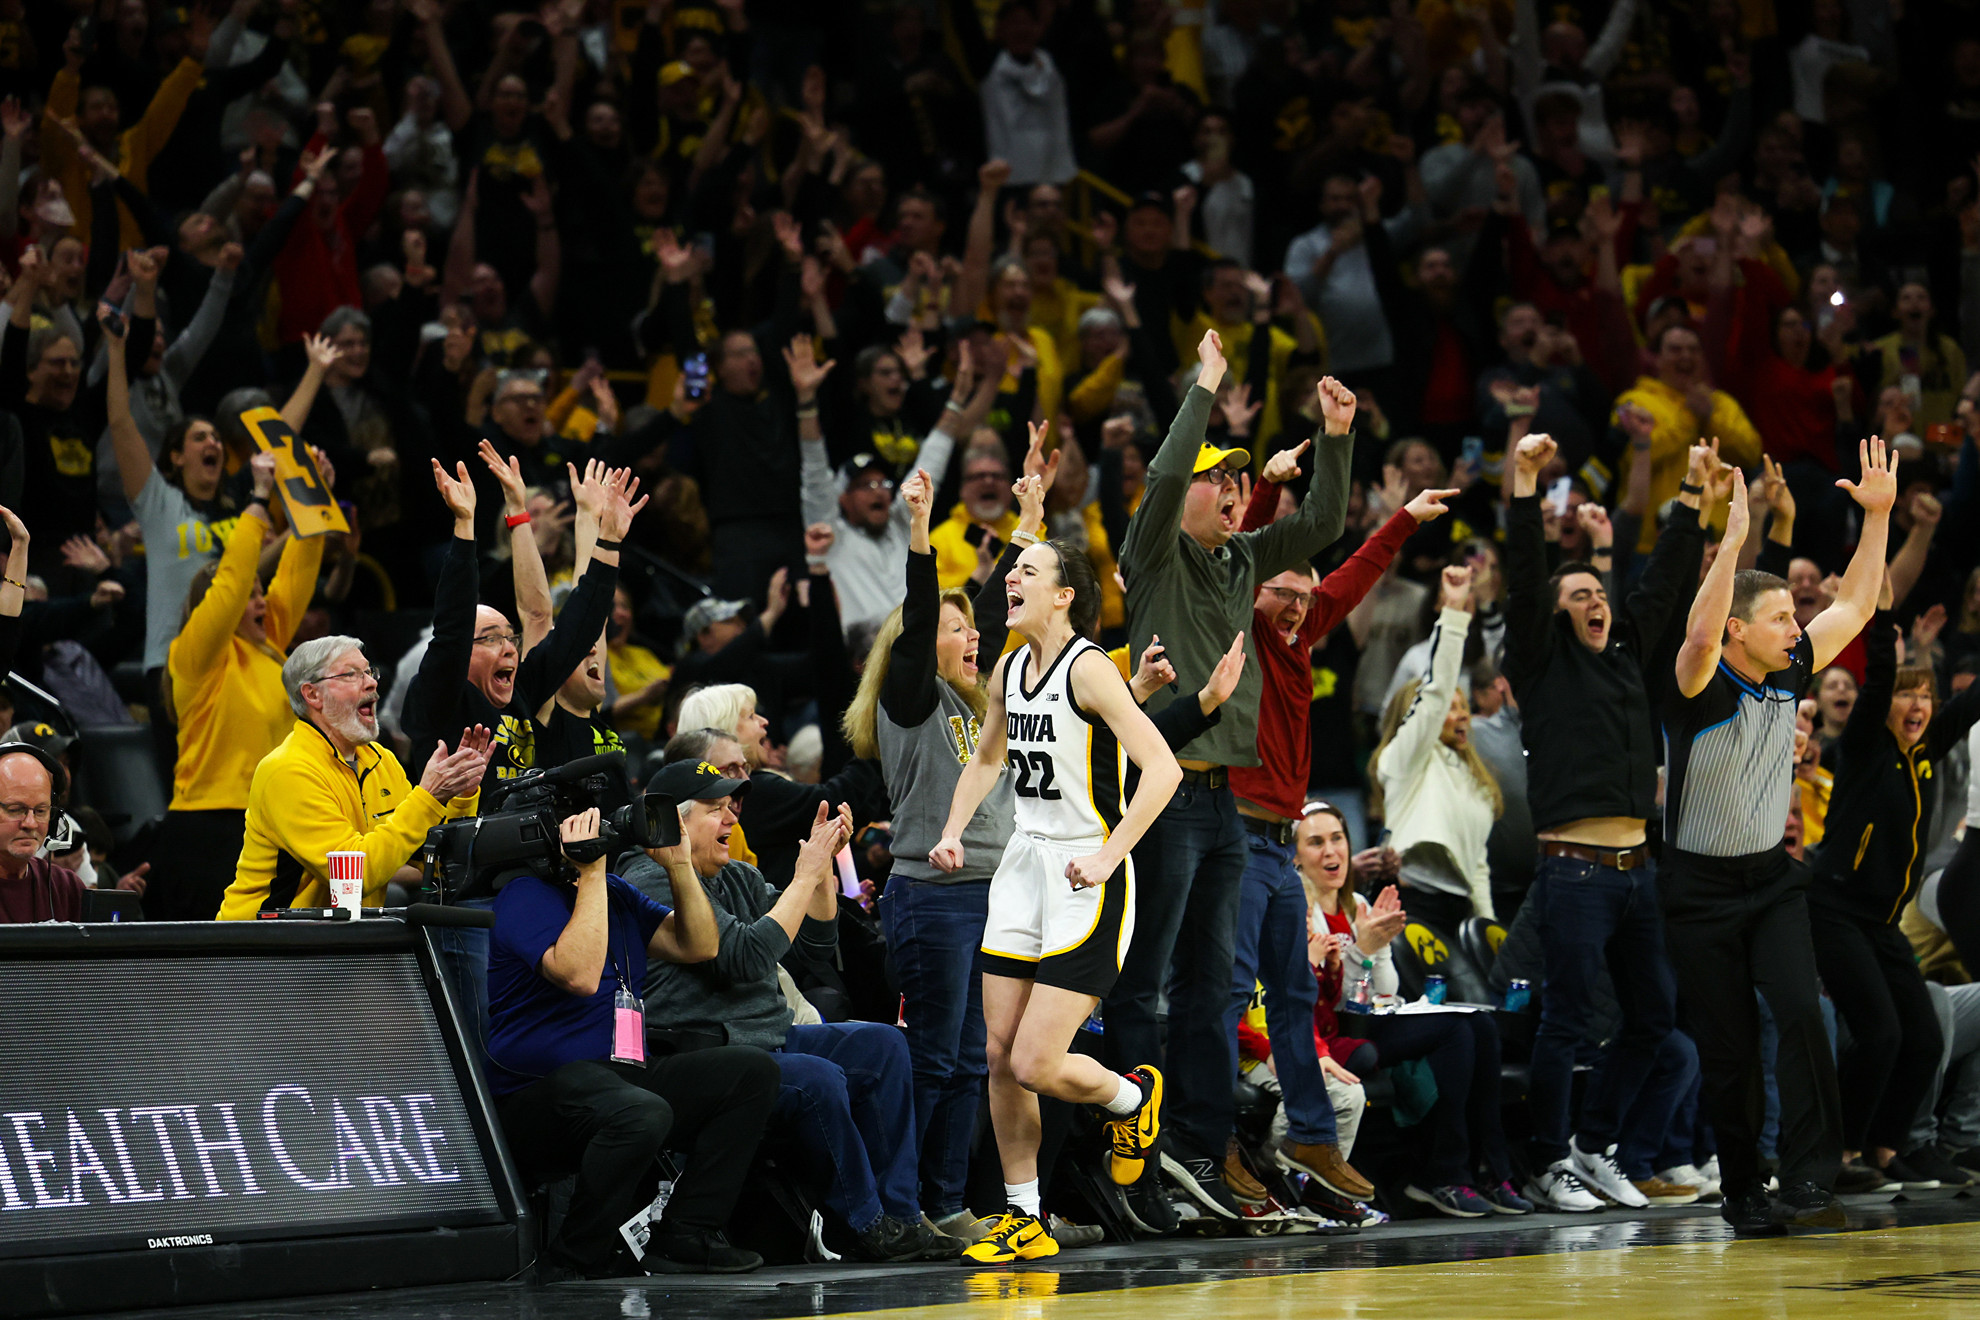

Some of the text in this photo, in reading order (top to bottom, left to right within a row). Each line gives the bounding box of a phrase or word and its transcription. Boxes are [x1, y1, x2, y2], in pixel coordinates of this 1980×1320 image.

[257, 419, 331, 506] 3
[176, 516, 240, 559] IOW
[1008, 749, 1062, 800] 22
[263, 1084, 461, 1190] CARE
[147, 1233, 213, 1249] DAKTRONICS
